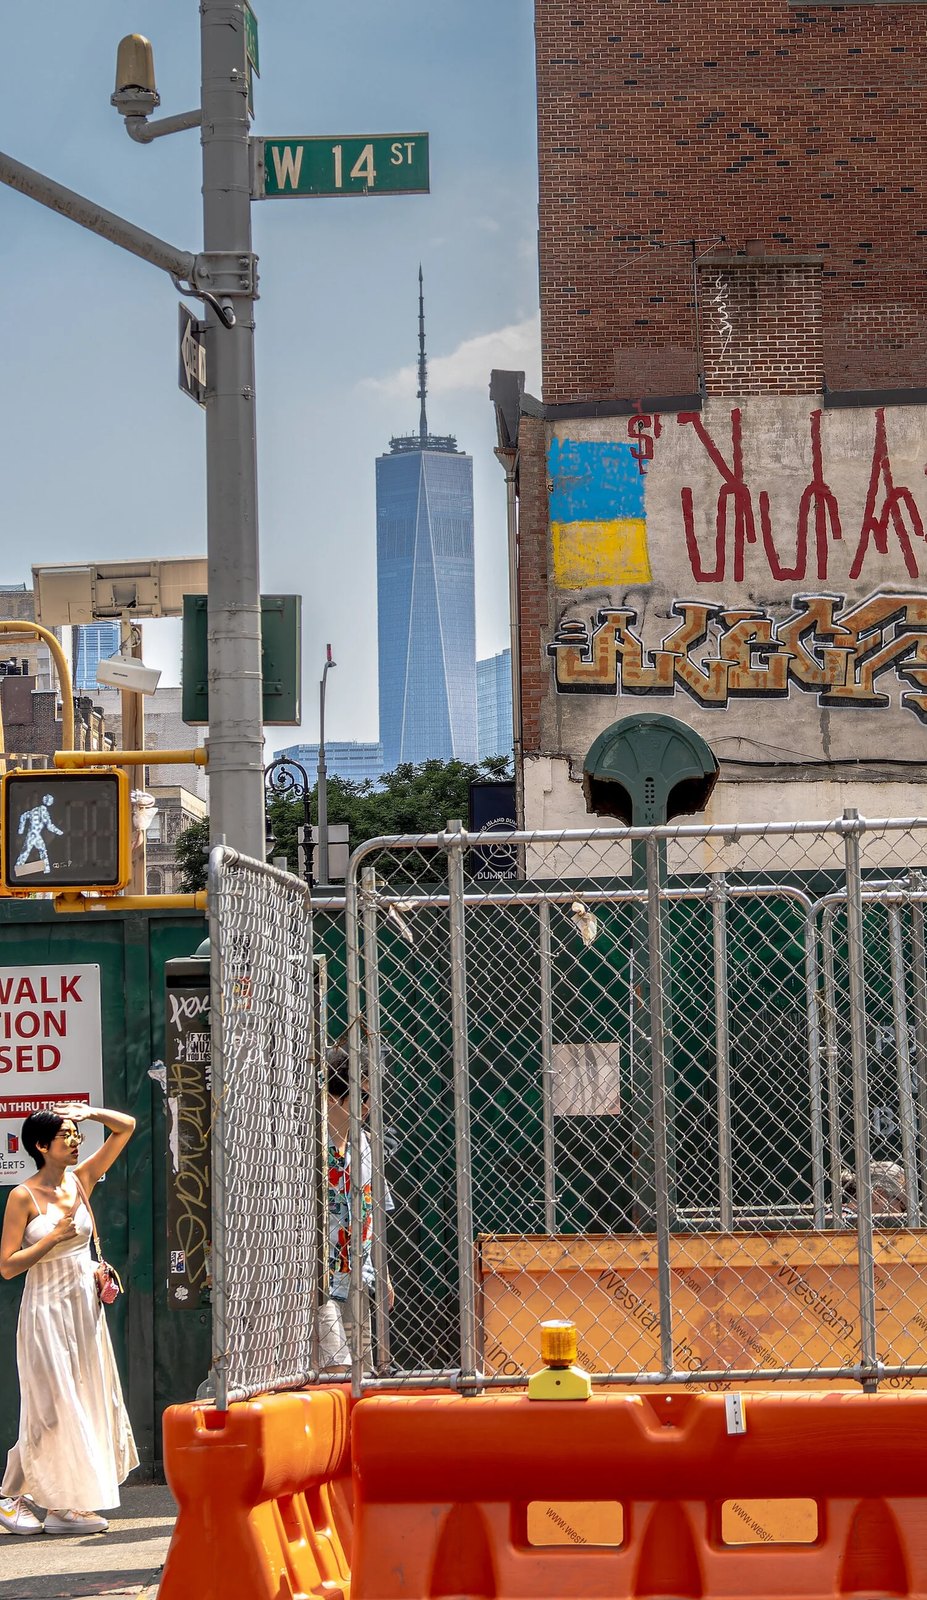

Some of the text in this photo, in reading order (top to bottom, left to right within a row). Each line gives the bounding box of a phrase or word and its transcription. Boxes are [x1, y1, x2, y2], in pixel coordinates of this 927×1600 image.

[272, 142, 415, 190] W 14 ST
[0, 1010, 67, 1039] ION
[8, 1101, 40, 1112] THRU
[778, 1265, 854, 1341] Westlam
